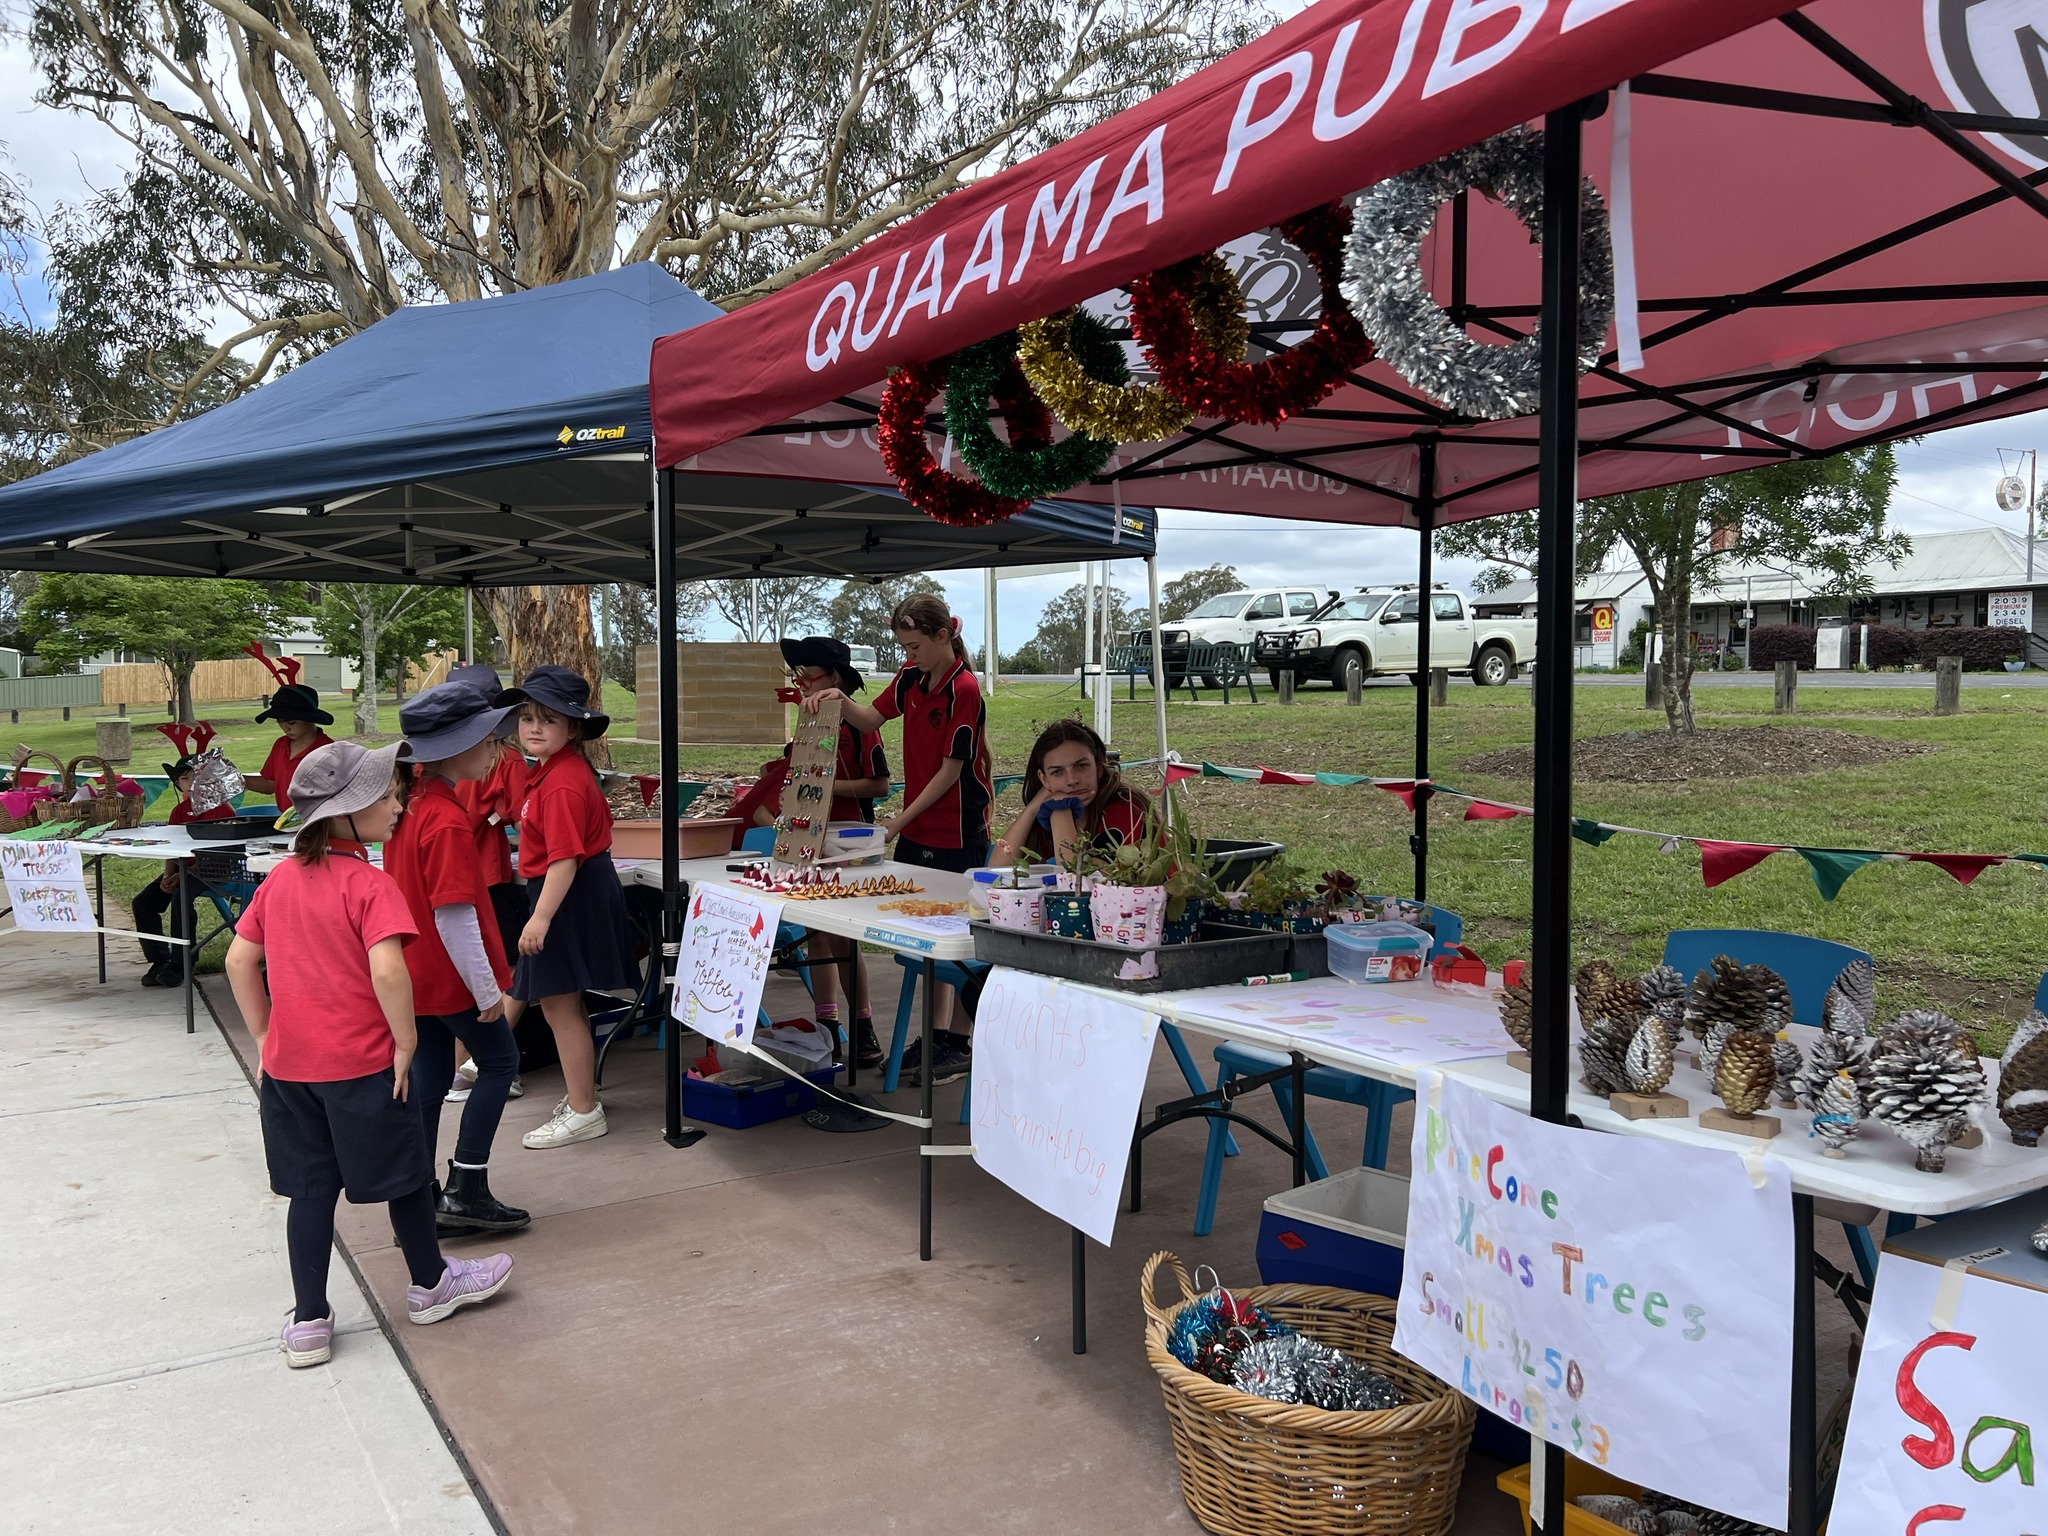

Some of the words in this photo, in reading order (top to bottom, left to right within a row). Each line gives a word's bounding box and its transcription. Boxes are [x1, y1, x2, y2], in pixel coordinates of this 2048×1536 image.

[805, 123, 1168, 374] QUAAMA
[1211, 0, 1636, 197] PUB
[2, 842, 31, 868] Mini
[984, 983, 1092, 1067] Plants
[1425, 1108, 1481, 1181] Pine
[1486, 1144, 1559, 1220] Cone
[1418, 1271, 1489, 1351] Small
[1454, 1196, 1535, 1289] Xmas
[1551, 1241, 1707, 1342] Trees
[1461, 1353, 1542, 1425] Large
[1572, 1413, 1610, 1465] $3
